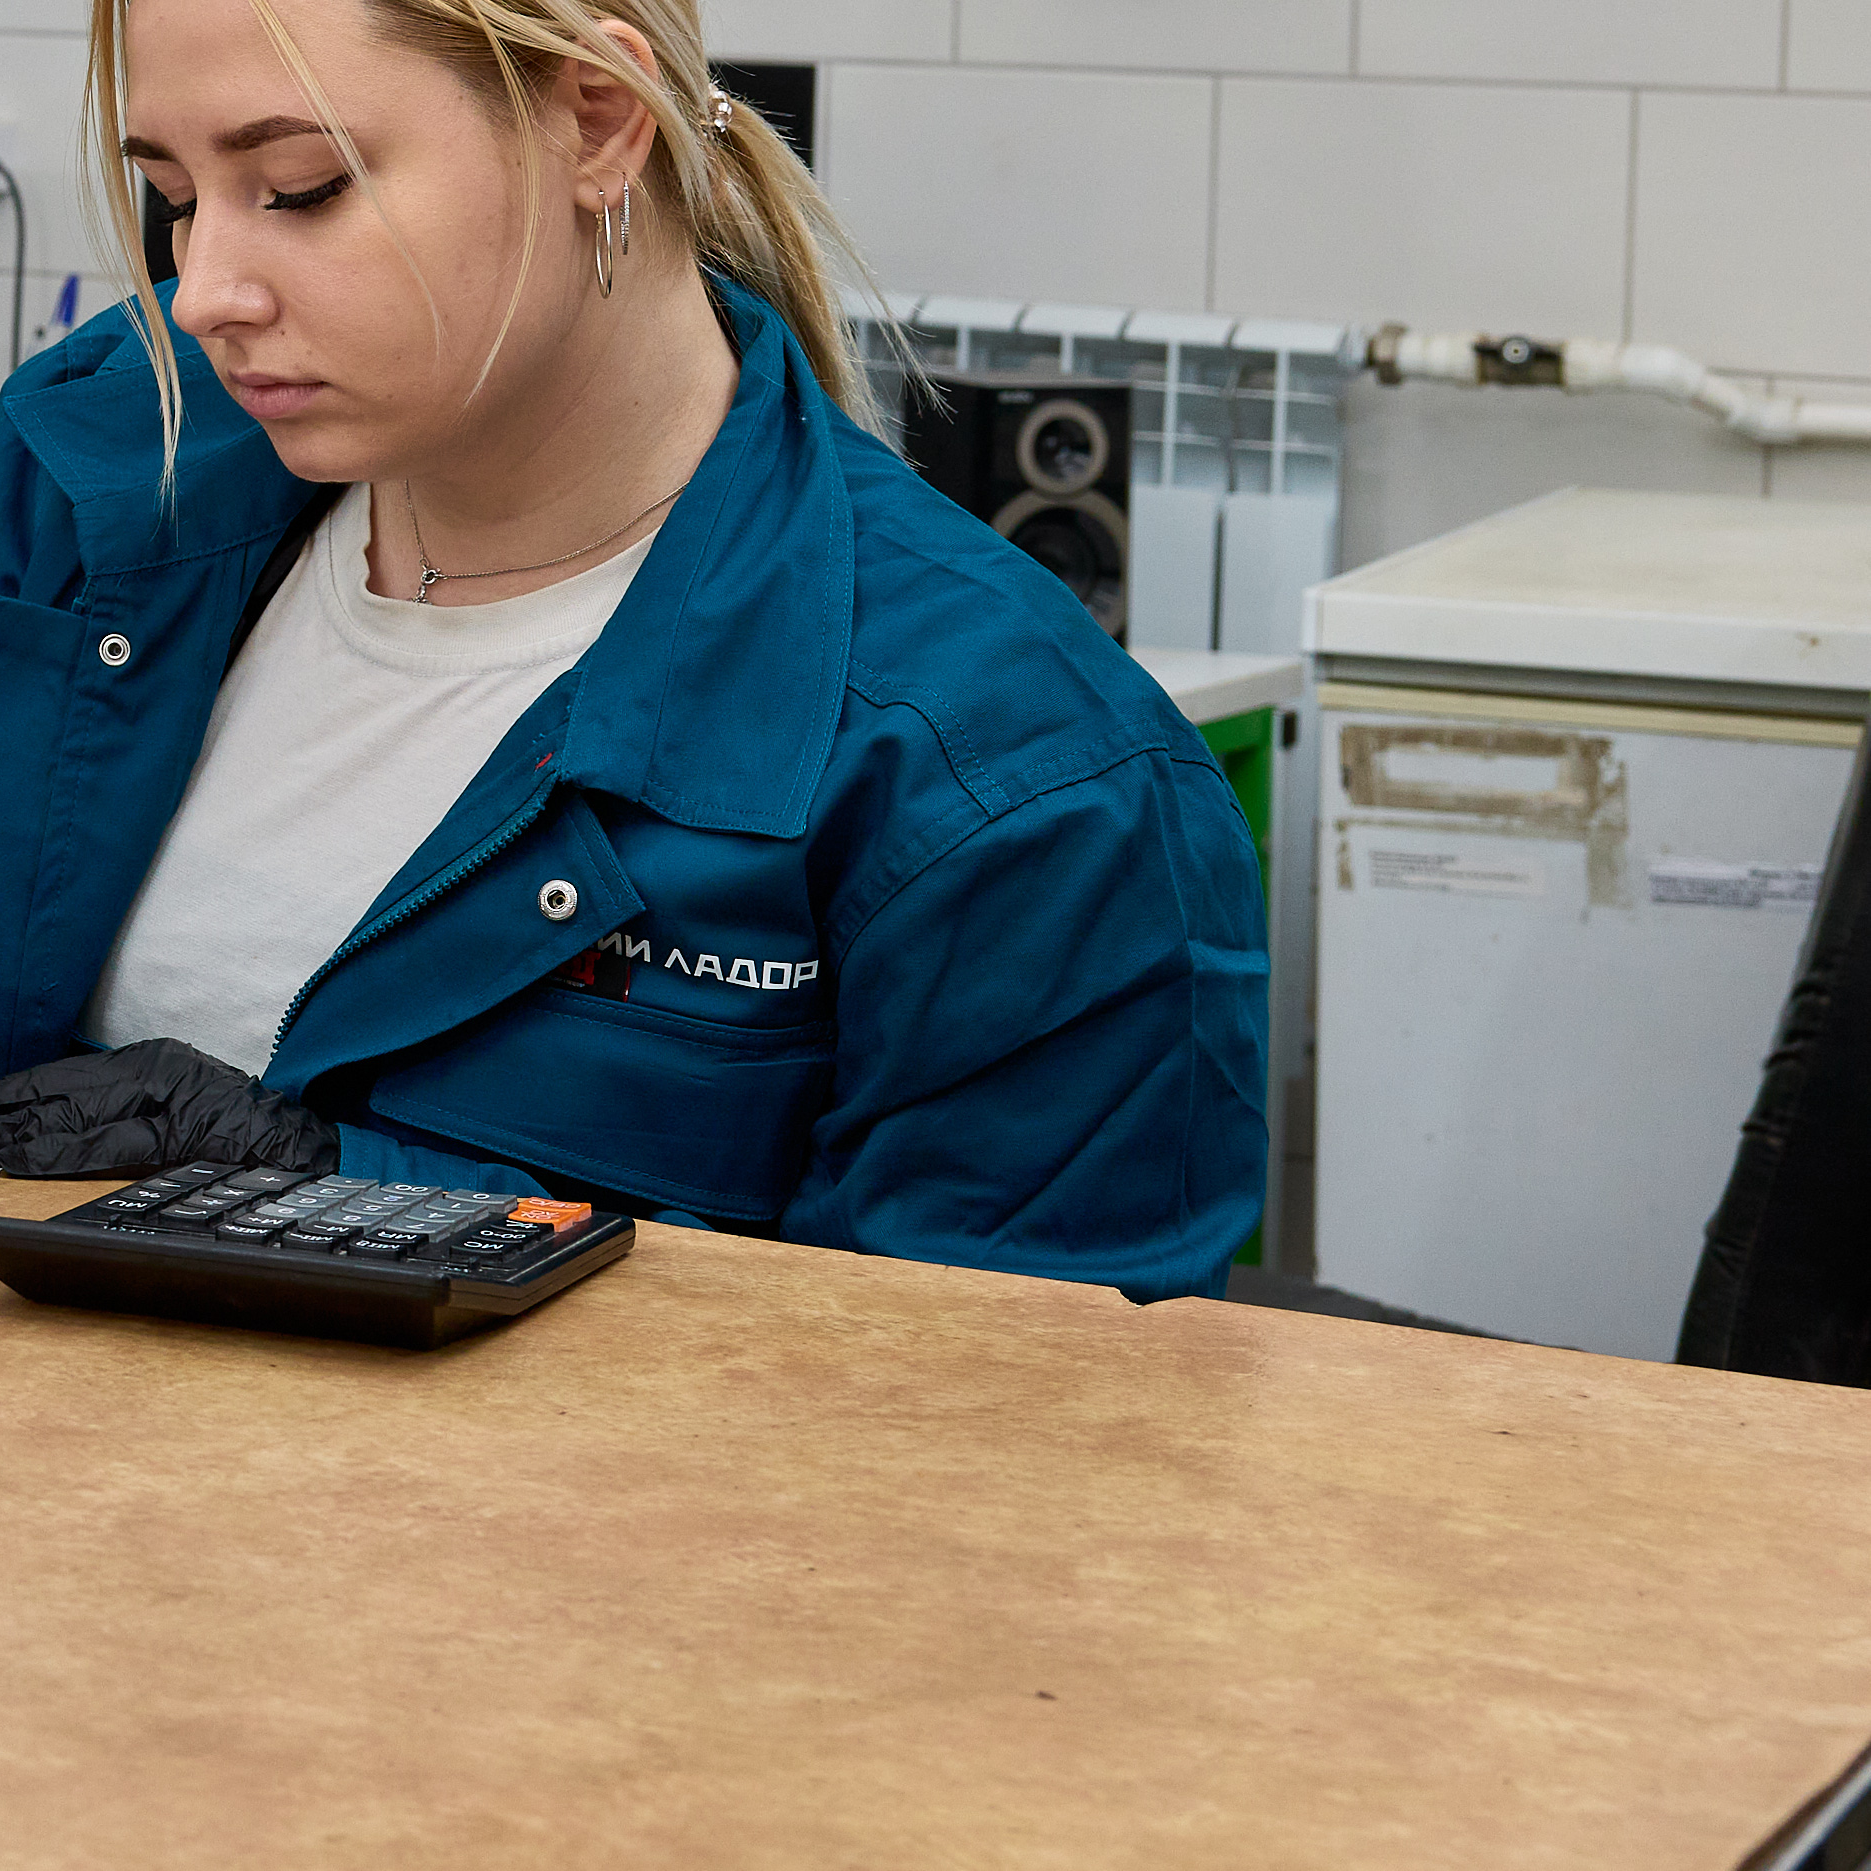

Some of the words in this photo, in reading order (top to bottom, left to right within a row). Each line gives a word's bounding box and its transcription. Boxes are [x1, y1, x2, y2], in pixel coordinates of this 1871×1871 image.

[394, 1184, 429, 1192] 00
[108, 1199, 147, 1209] MU
[298, 1197, 317, 1205] 6
[247, 1216, 283, 1225] M+
[377, 1230, 418, 1240] MR
[463, 1241, 504, 1250] MC
